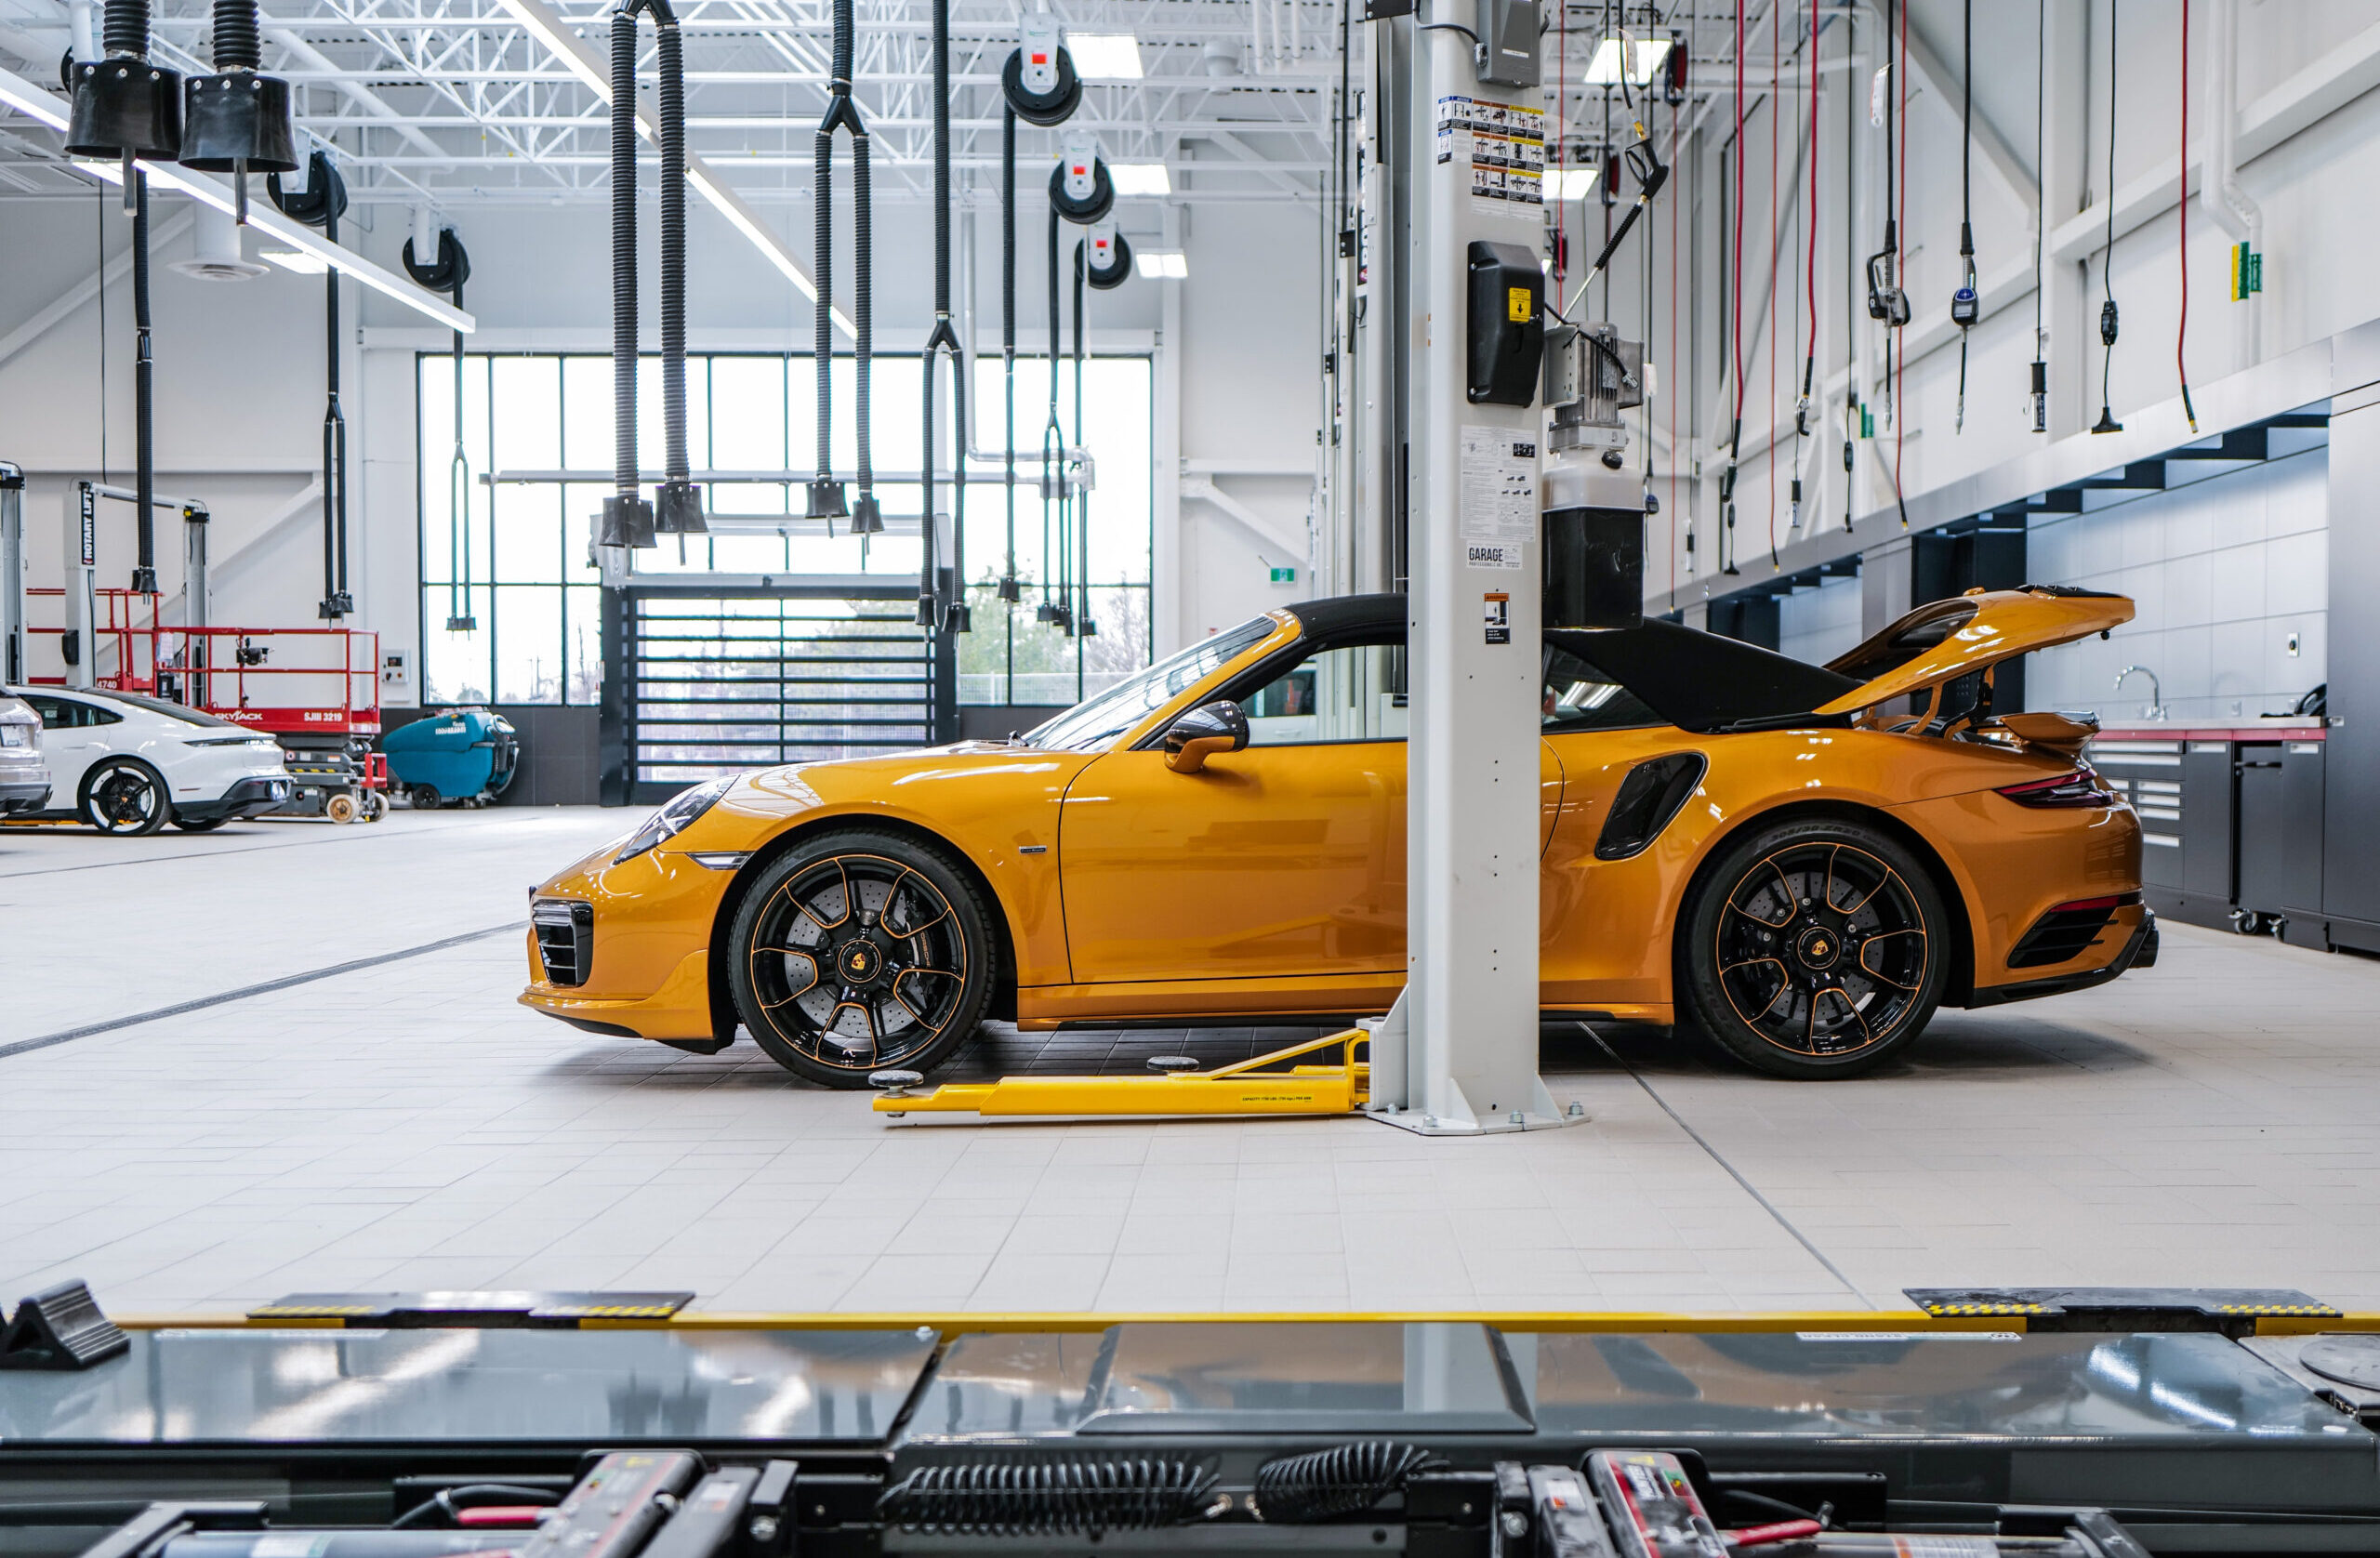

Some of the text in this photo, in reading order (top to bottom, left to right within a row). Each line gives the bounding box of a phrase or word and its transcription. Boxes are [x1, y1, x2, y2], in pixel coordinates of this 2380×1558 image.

[83, 518, 93, 559] ROTARY
[1469, 547, 1503, 561] GARAGE
[97, 680, 117, 690] 4740
[323, 712, 343, 722] 3219
